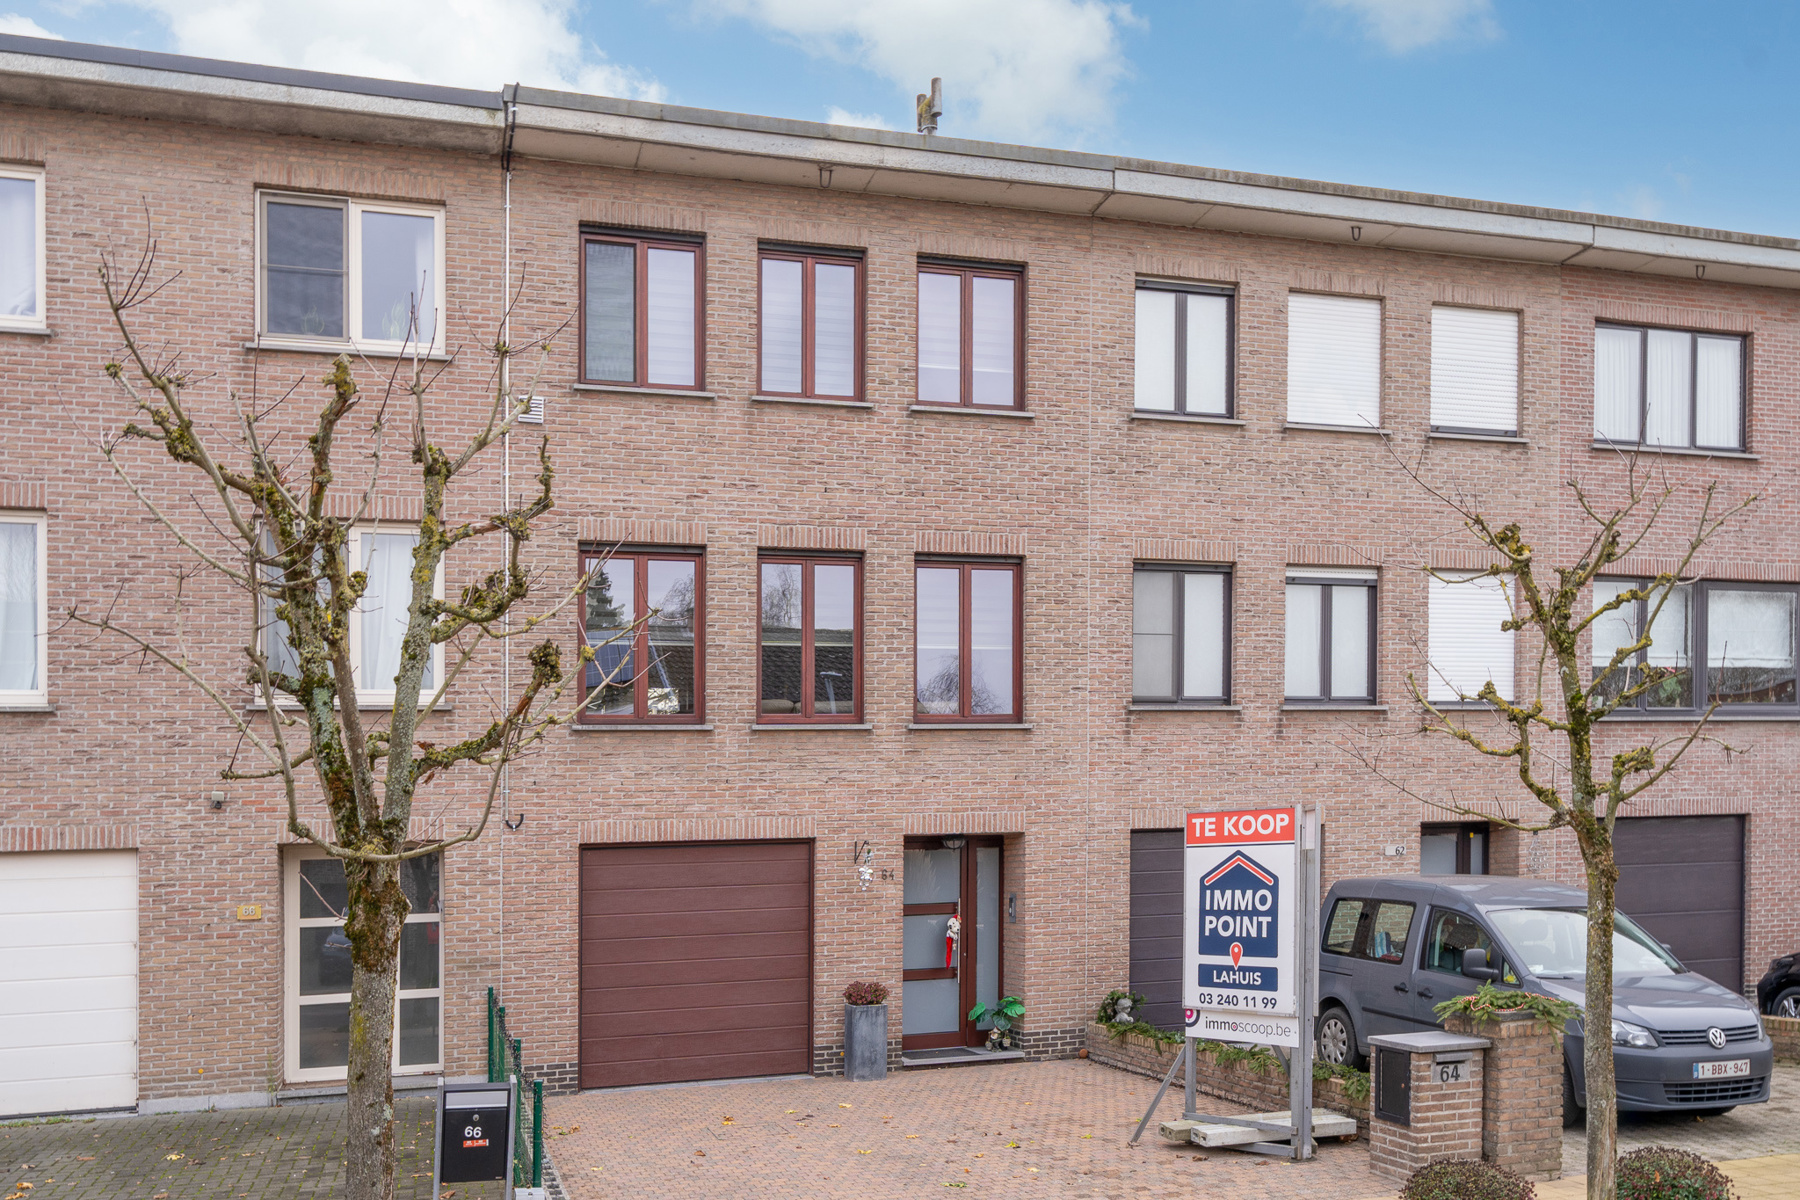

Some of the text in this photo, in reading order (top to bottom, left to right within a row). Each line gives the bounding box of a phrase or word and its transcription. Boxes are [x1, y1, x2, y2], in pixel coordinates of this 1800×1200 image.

[1191, 813, 1290, 837] TE KOOP
[1395, 846, 1405, 856] 62
[881, 869, 894, 880] 64
[1205, 888, 1272, 912] IMMO
[242, 906, 256, 916] 66
[1204, 915, 1272, 938] POINT
[1212, 969, 1262, 986] LAHUIS
[1199, 992, 1277, 1010] 03 240 11 99
[1205, 1015, 1291, 1038] immoscoop.be
[1439, 1064, 1461, 1083] 64
[464, 1126, 482, 1138] 66
